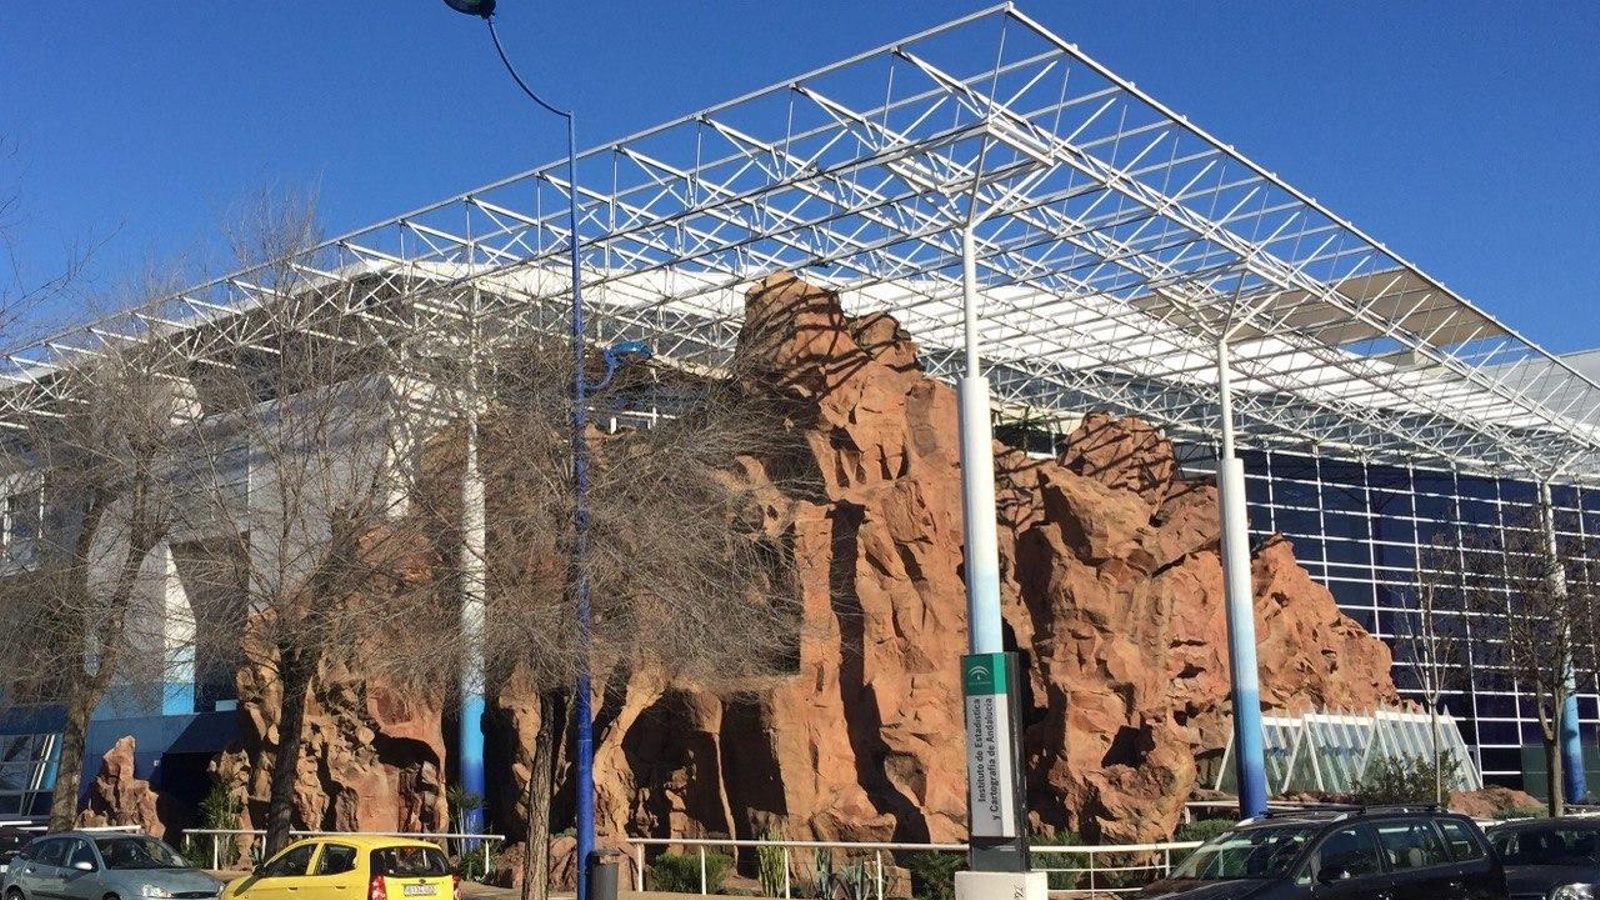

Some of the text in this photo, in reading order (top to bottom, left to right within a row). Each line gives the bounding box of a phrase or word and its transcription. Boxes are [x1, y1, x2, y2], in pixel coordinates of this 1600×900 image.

[975, 750, 983, 762] de
[986, 745, 995, 757] de
[976, 763, 986, 802] Instituto
